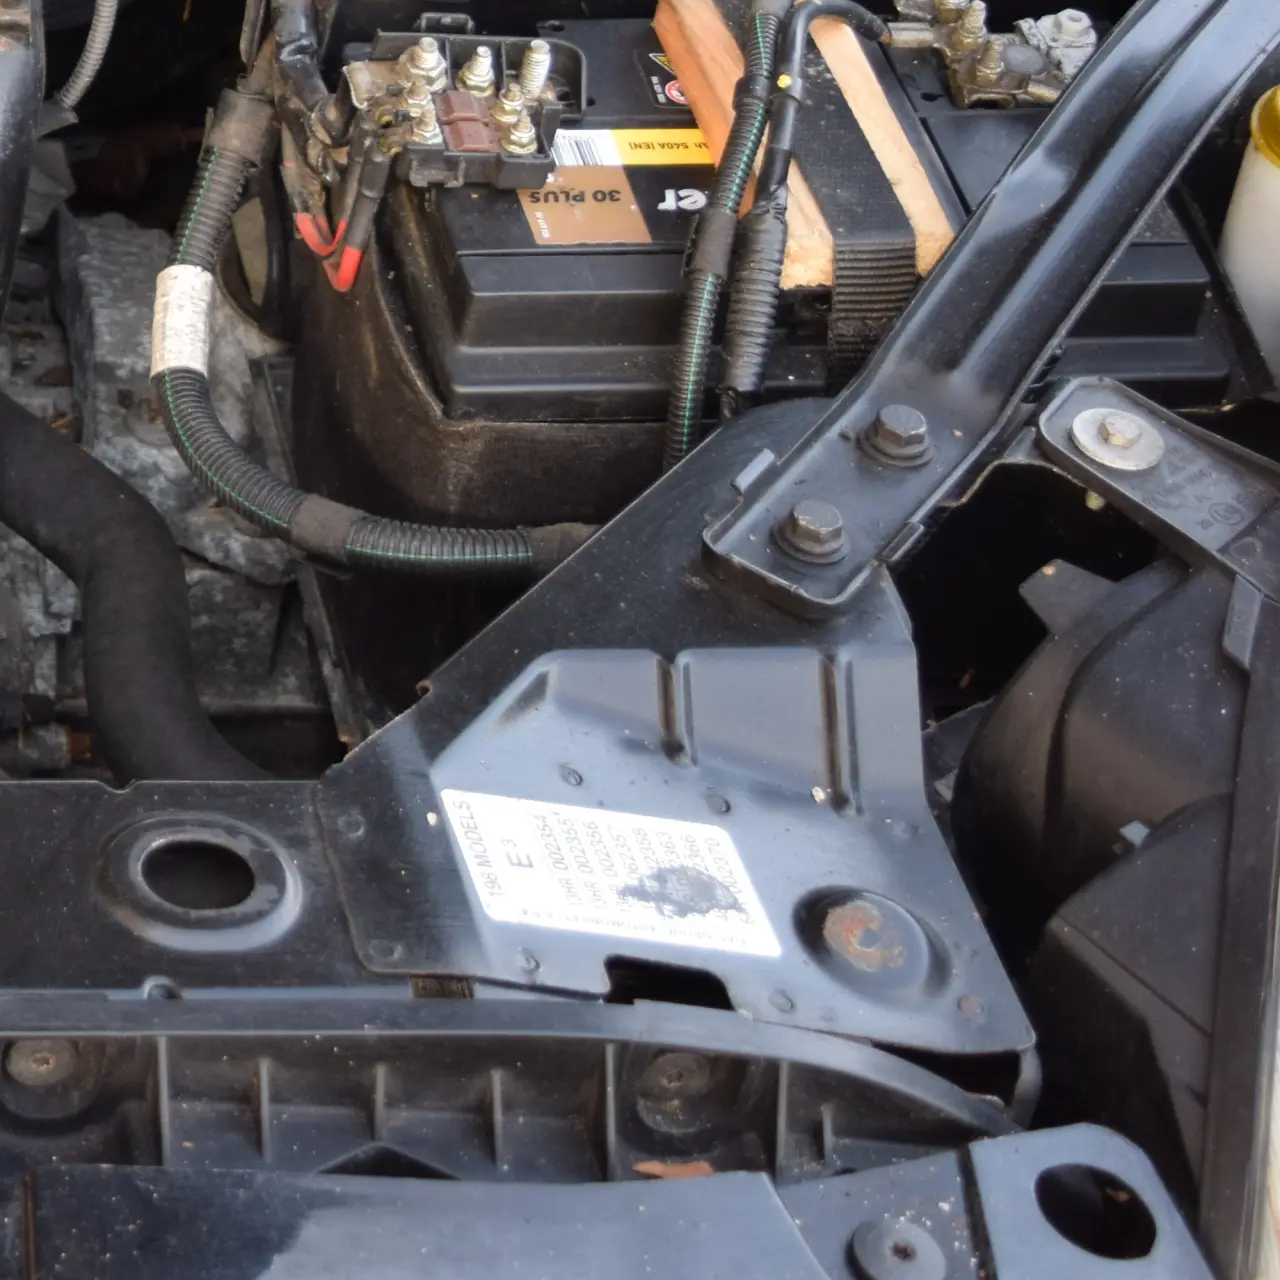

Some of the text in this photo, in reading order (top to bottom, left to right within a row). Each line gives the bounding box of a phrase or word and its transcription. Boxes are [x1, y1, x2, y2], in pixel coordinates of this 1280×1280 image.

[657, 141, 689, 150] 540A
[528, 189, 621, 204] 30 PLUS
[451, 799, 503, 897] 198 MODELS
[532, 813, 569, 871] 002354
[581, 820, 618, 877] 002356
